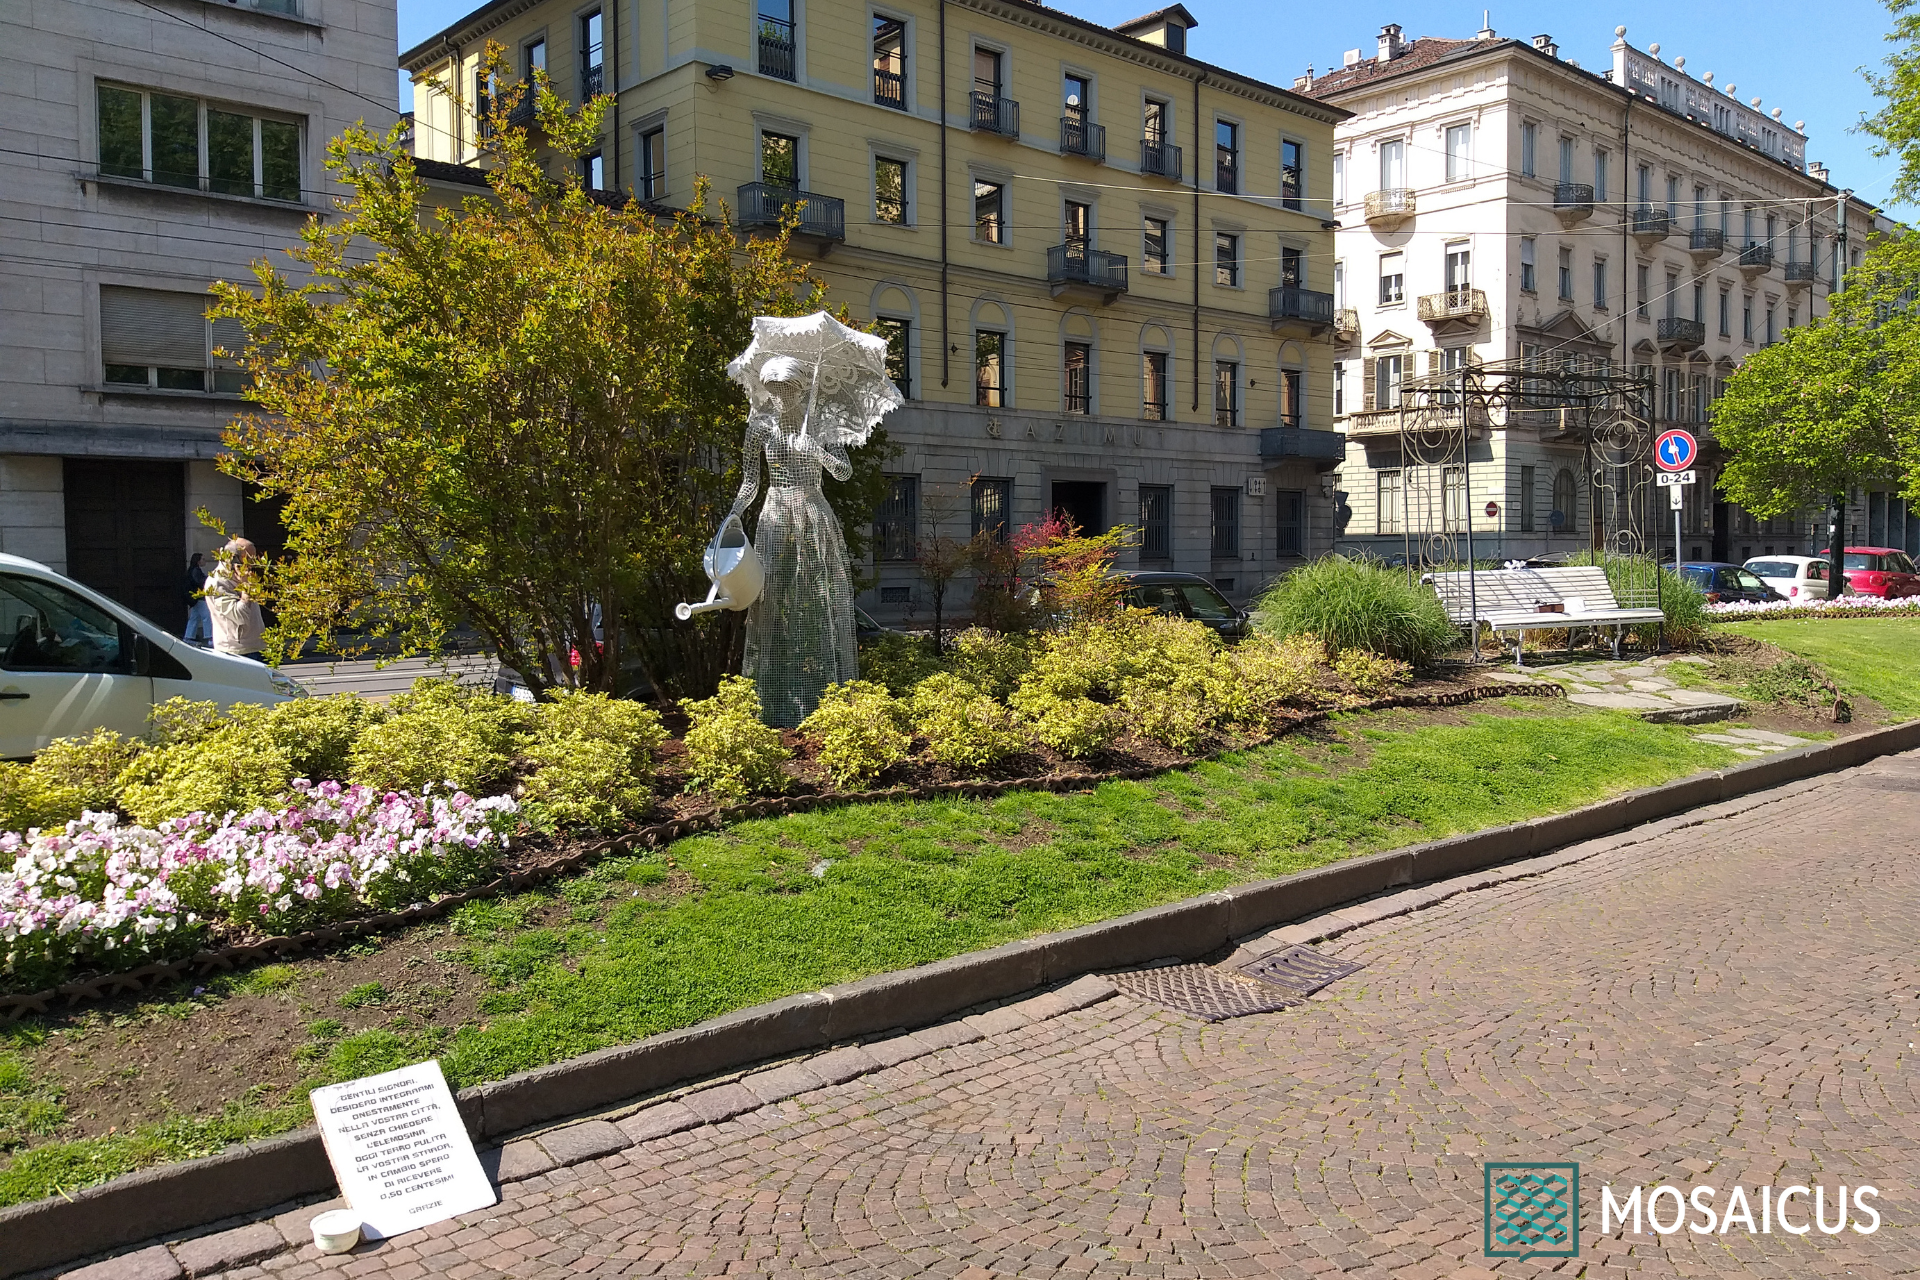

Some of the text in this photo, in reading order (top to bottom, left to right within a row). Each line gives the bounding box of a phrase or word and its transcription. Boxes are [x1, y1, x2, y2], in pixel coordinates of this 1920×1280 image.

[1661, 473, 1690, 483] 0-24
[330, 1084, 434, 1114] DESIDERO INTEGRARMI
[340, 1087, 376, 1101] GENTILI
[352, 1098, 420, 1120] ONESTAMENTE
[338, 1122, 369, 1133] NELLA
[372, 1112, 408, 1126] VOSTRA
[354, 1115, 433, 1141] SENZA CHIEDERE
[355, 1133, 447, 1162] OGGI TERRO PULITA
[368, 1154, 450, 1182] IN CAMBIO SPERO
[372, 1155, 410, 1169] VOSTRA
[380, 1174, 454, 1200] 0,50 CENTESIMI
[384, 1167, 442, 1188] DI RICEVERE
[409, 1200, 442, 1214] GRAZIE
